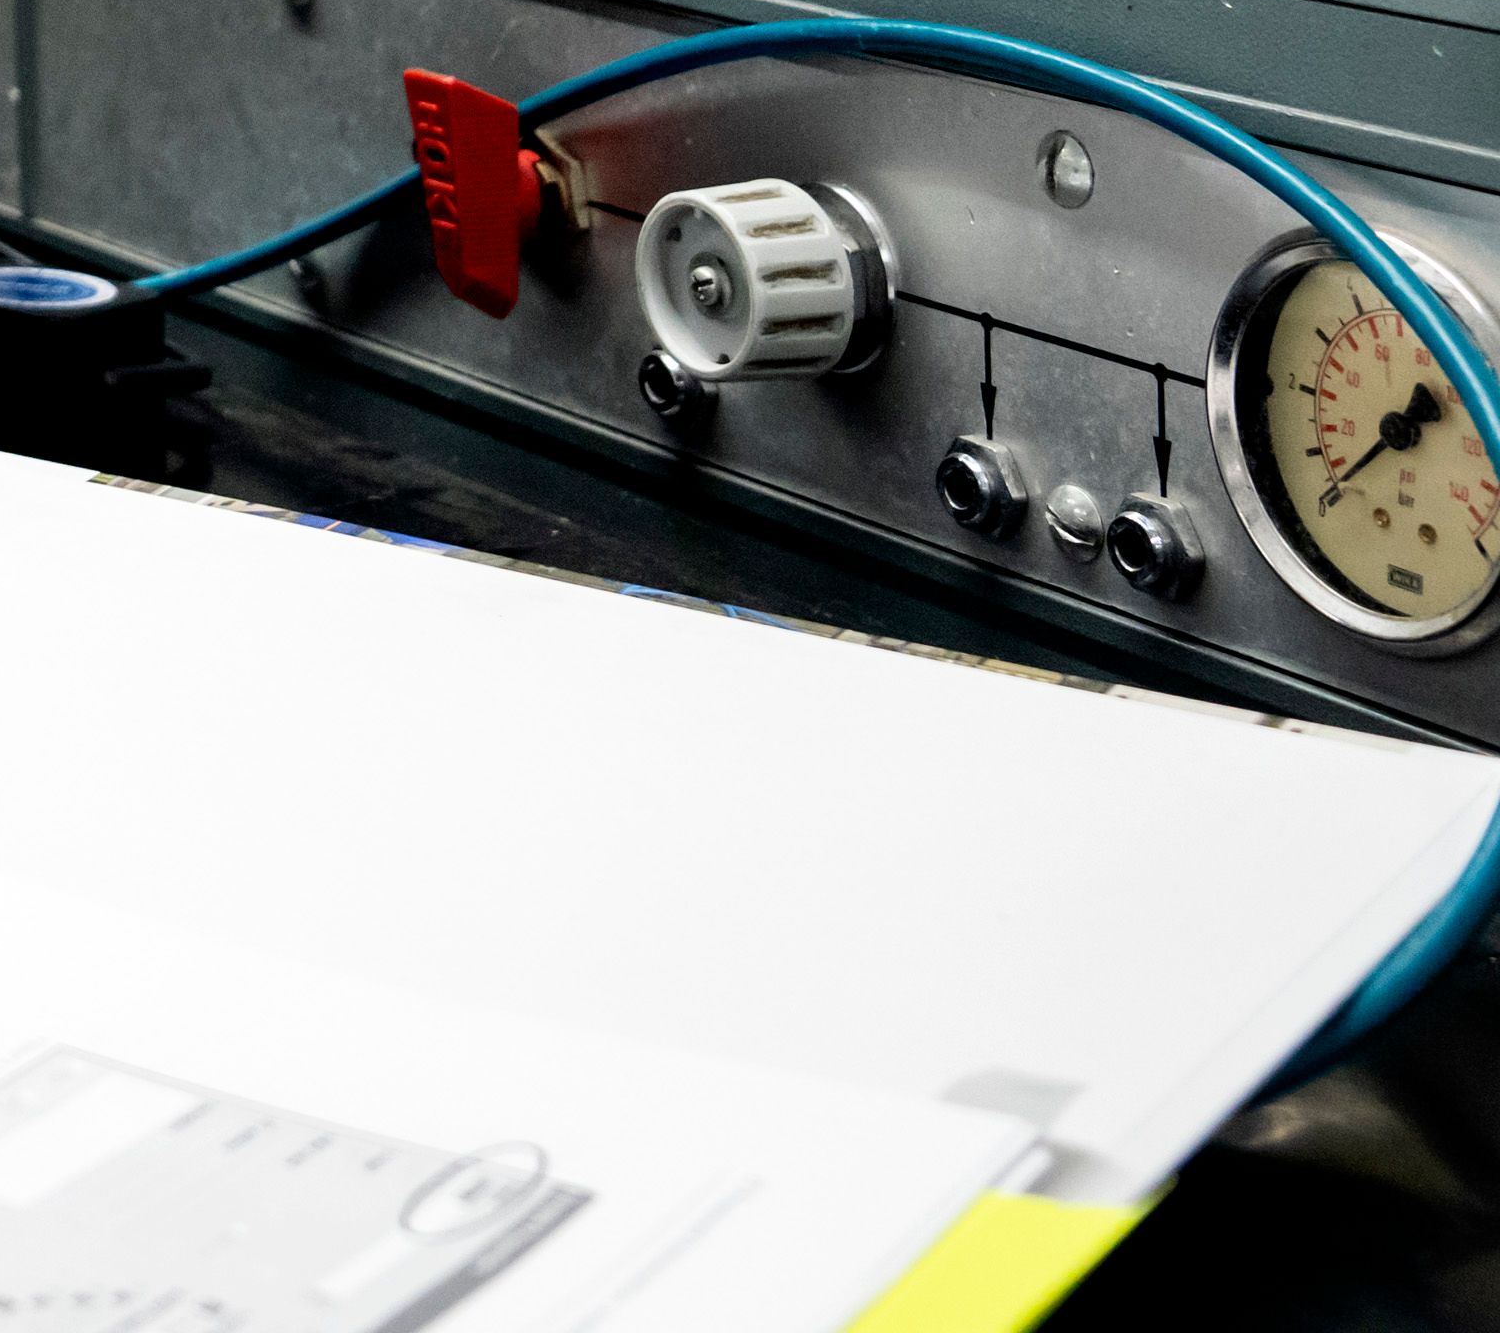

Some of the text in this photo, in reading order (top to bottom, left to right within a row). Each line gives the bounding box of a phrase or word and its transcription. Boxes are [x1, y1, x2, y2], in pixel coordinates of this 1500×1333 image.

[1374, 343, 1390, 363] 60
[1288, 372, 1296, 390] 2
[1346, 369, 1361, 389] 40
[1340, 418, 1356, 437] 20
